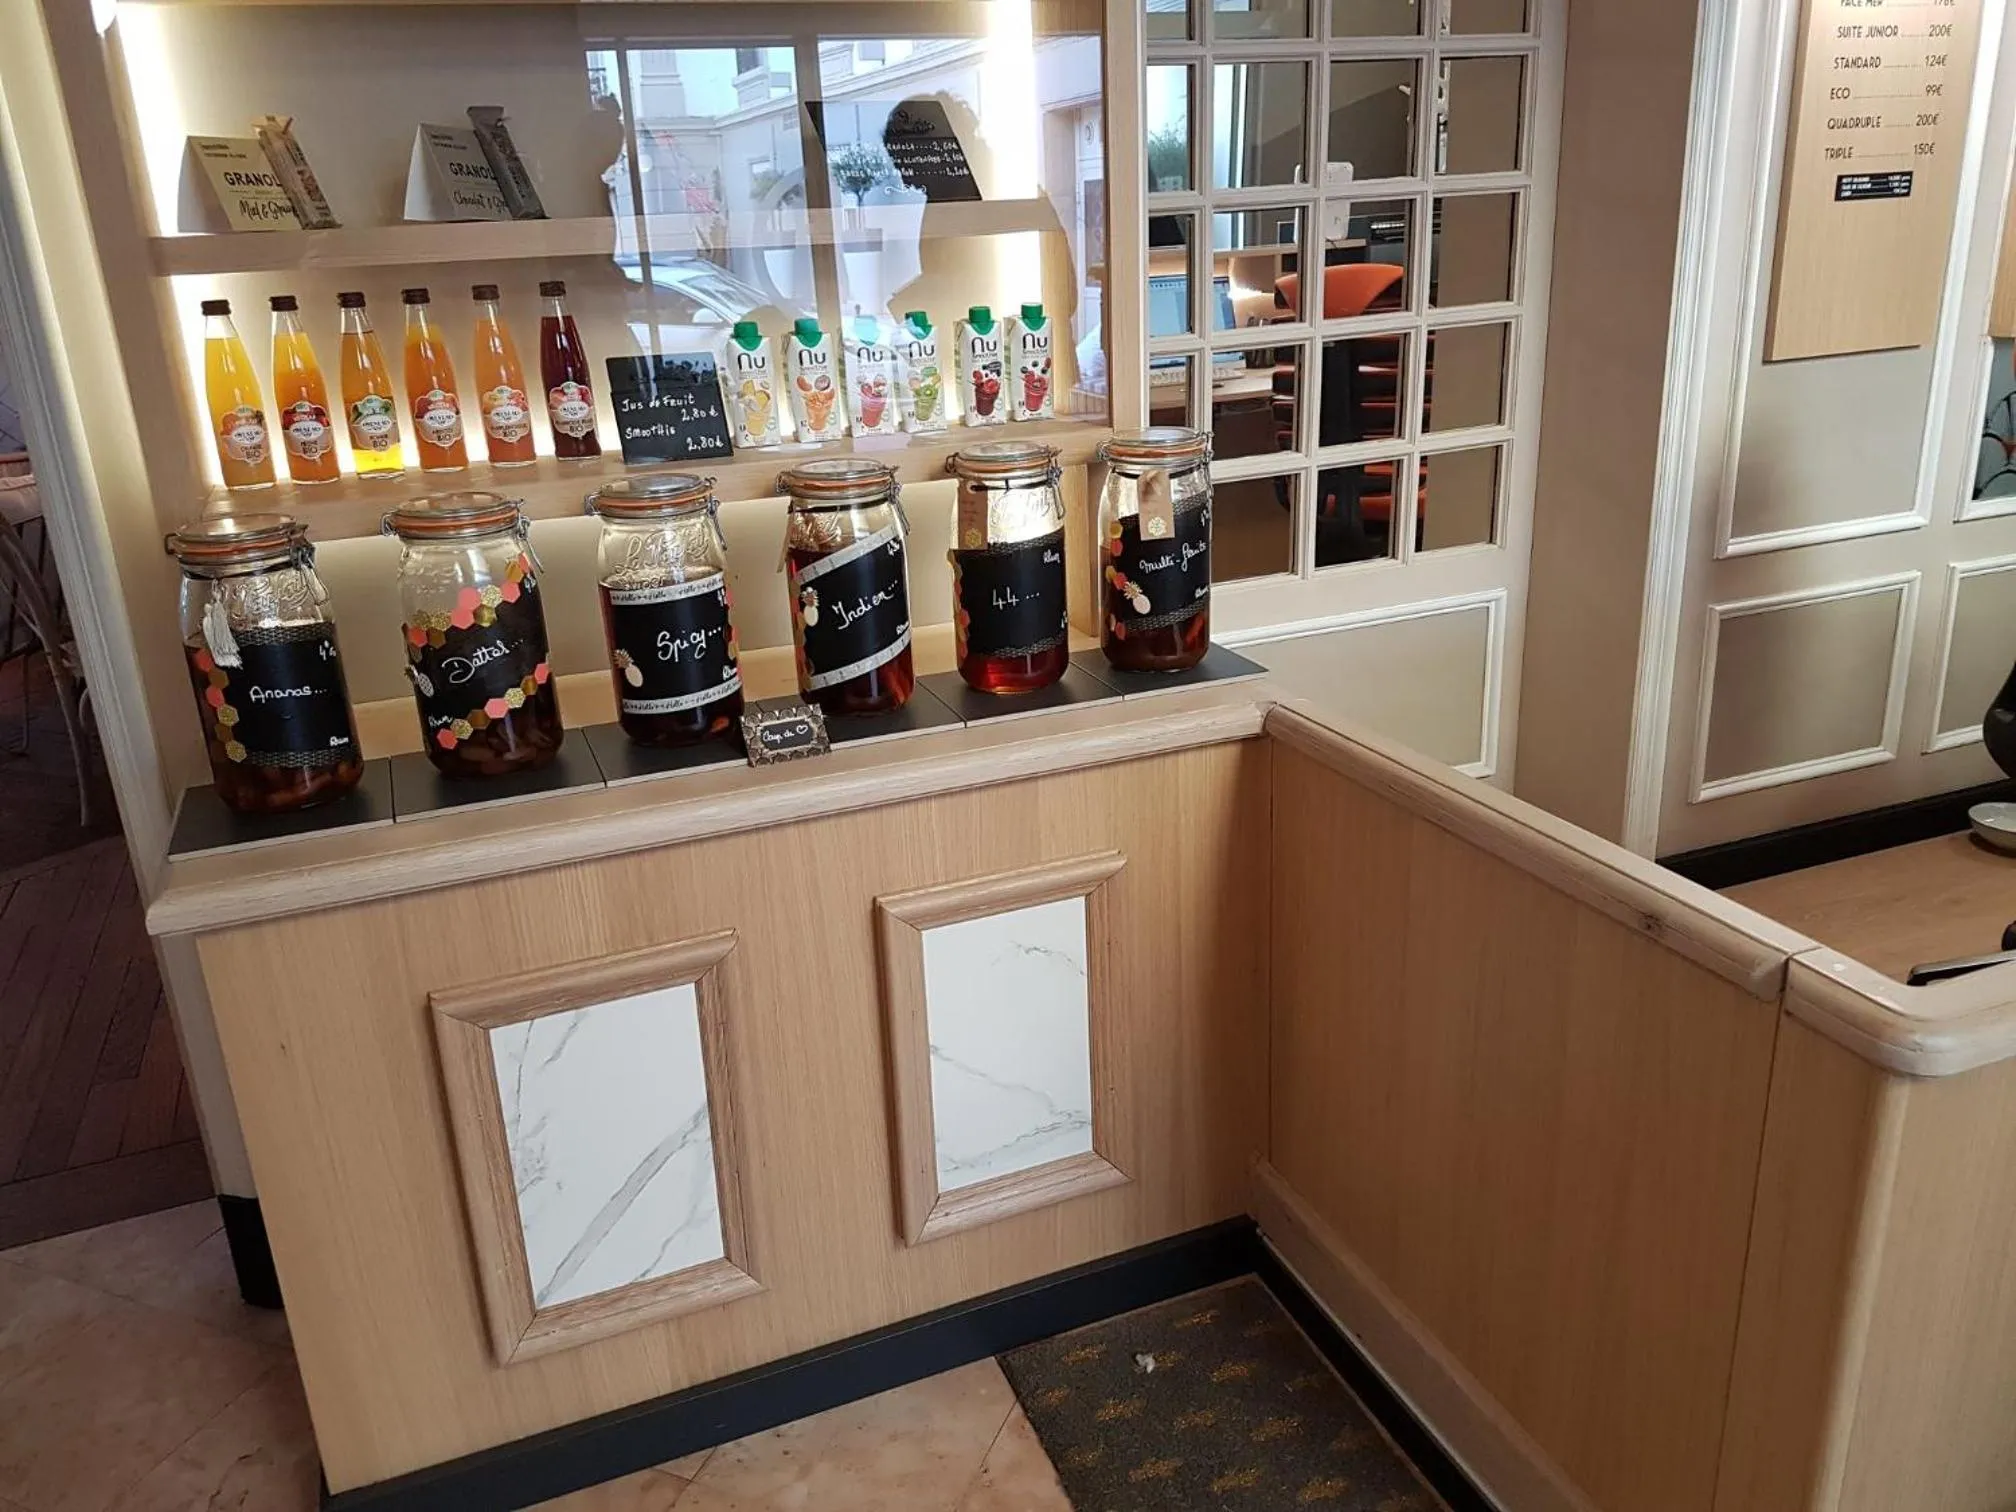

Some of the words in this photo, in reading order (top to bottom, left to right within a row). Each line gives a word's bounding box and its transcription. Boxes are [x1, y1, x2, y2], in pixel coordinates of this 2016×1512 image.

[1837, 25, 1863, 38] SUITE
[1865, 25, 1899, 38] JUNIOR
[1928, 24, 1954, 37] 200€
[1833, 56, 1882, 69] STANDARD
[1924, 55, 1948, 67] 124€
[1830, 87, 1850, 100] ECO
[1925, 84, 1944, 96] 99€
[1826, 116, 1882, 130] QUADRUPLE
[1916, 114, 1940, 126] 200€
[1824, 147, 1854, 160] TRIPLE
[1913, 142, 1936, 155] 150€
[223, 171, 283, 186] GRANOL
[449, 161, 497, 181] GRANOL
[622, 398, 643, 412] Jus
